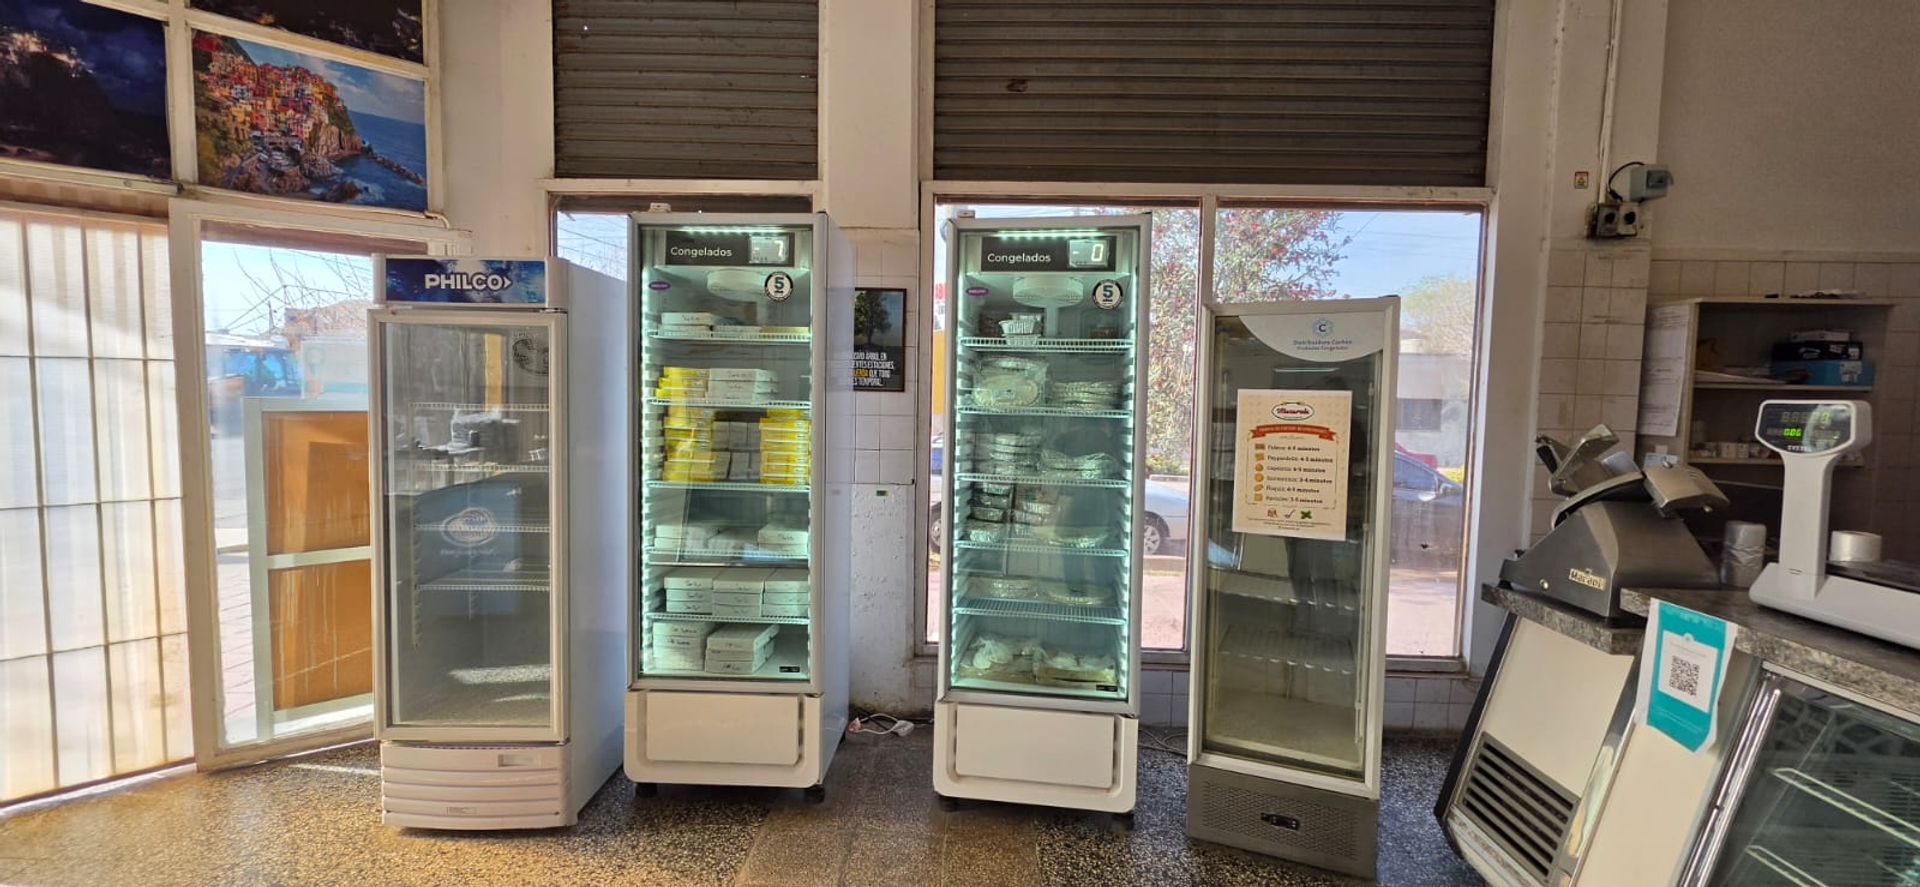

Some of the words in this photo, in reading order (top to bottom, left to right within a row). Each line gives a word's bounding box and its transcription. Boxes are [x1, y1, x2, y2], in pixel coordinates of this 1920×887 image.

[670, 247, 732, 260] Congelados
[987, 252, 1051, 264] Congelados
[424, 273, 503, 290] PHILCO
[774, 276, 784, 290] 5
[1103, 285, 1113, 298] 5
